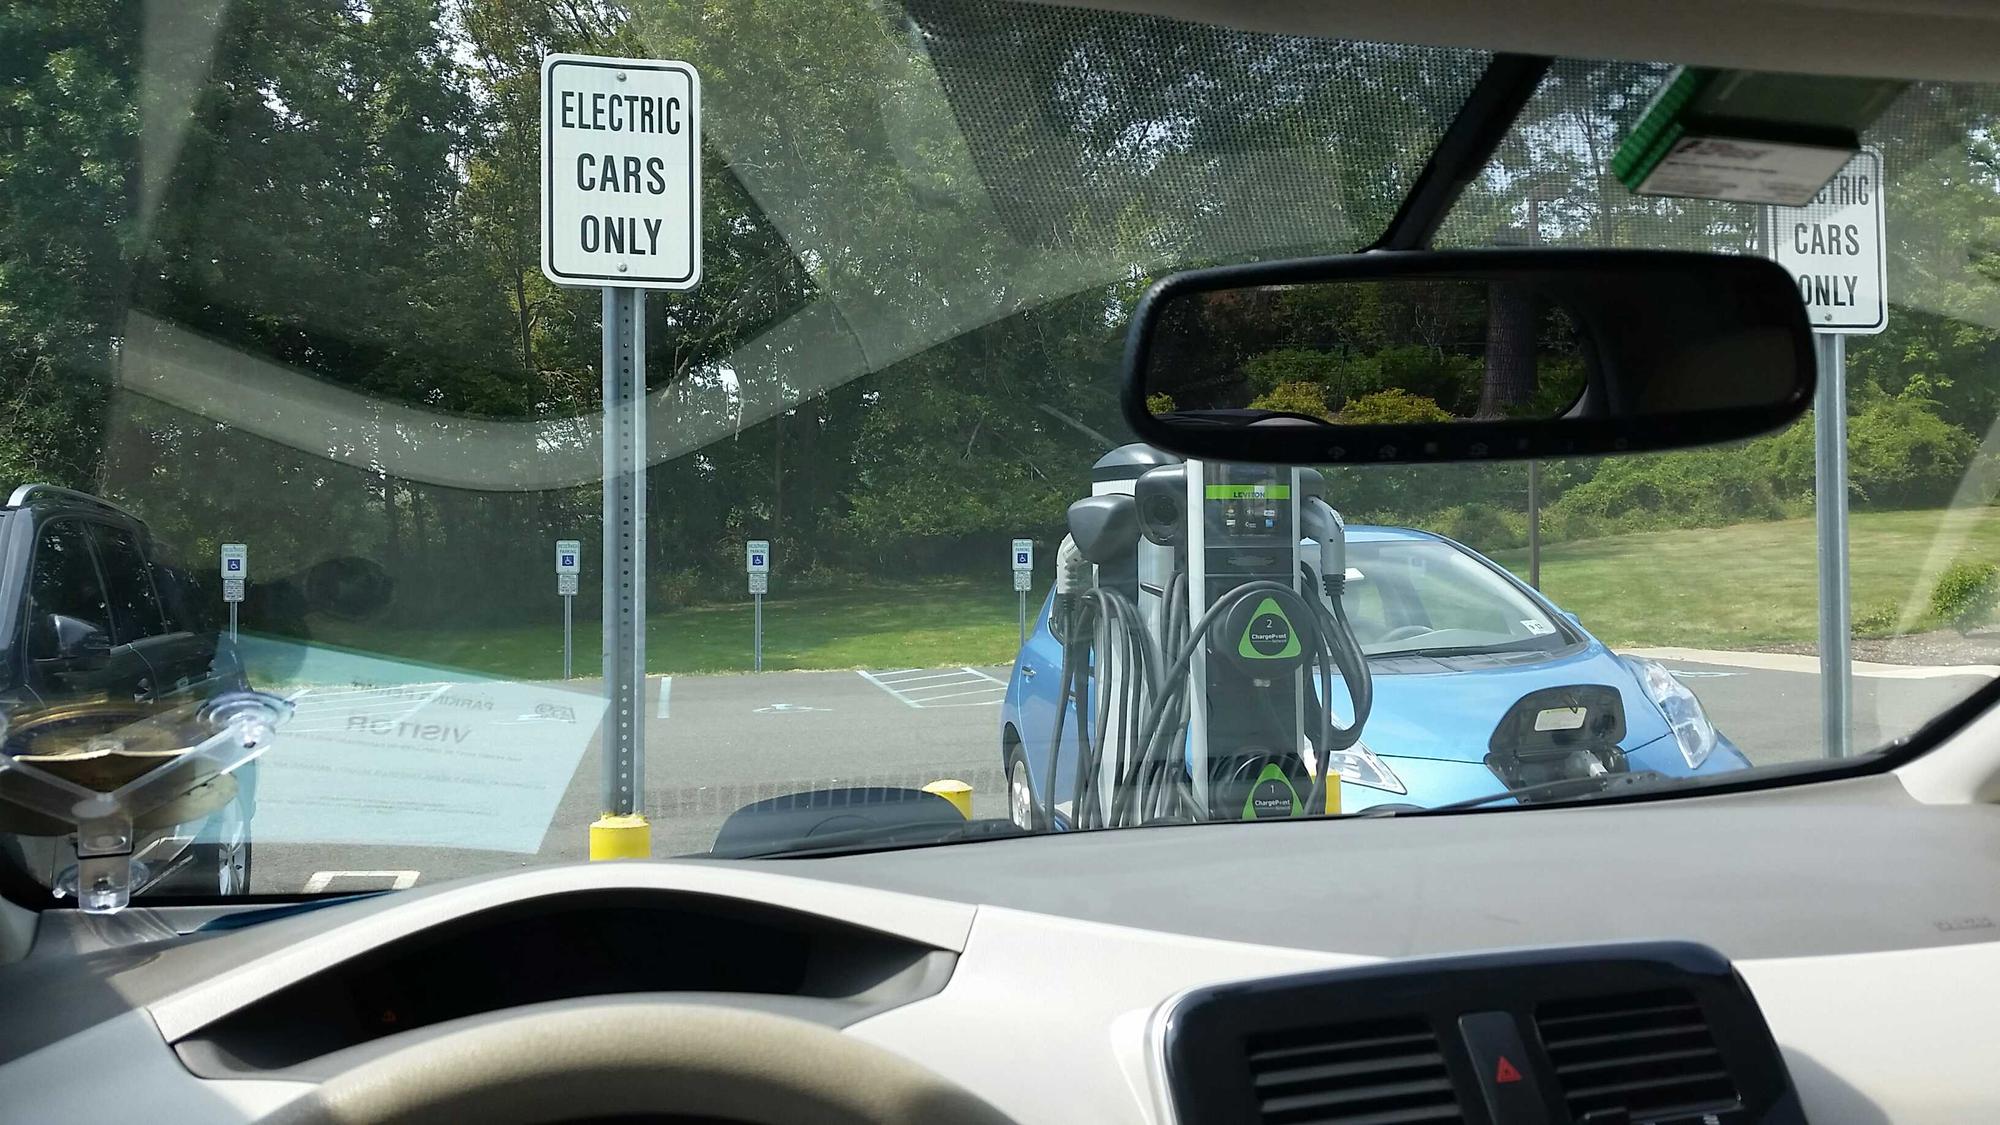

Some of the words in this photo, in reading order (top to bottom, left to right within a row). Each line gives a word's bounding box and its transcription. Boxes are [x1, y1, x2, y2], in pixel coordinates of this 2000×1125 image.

[561, 90, 681, 135] ELECTRIC
[576, 152, 666, 195] CARS
[580, 214, 663, 256] ONLY
[1794, 222, 1860, 256] CARS
[1797, 274, 1858, 307] ONLY
[1266, 619, 1273, 628] 2
[1270, 784, 1275, 794] 1
